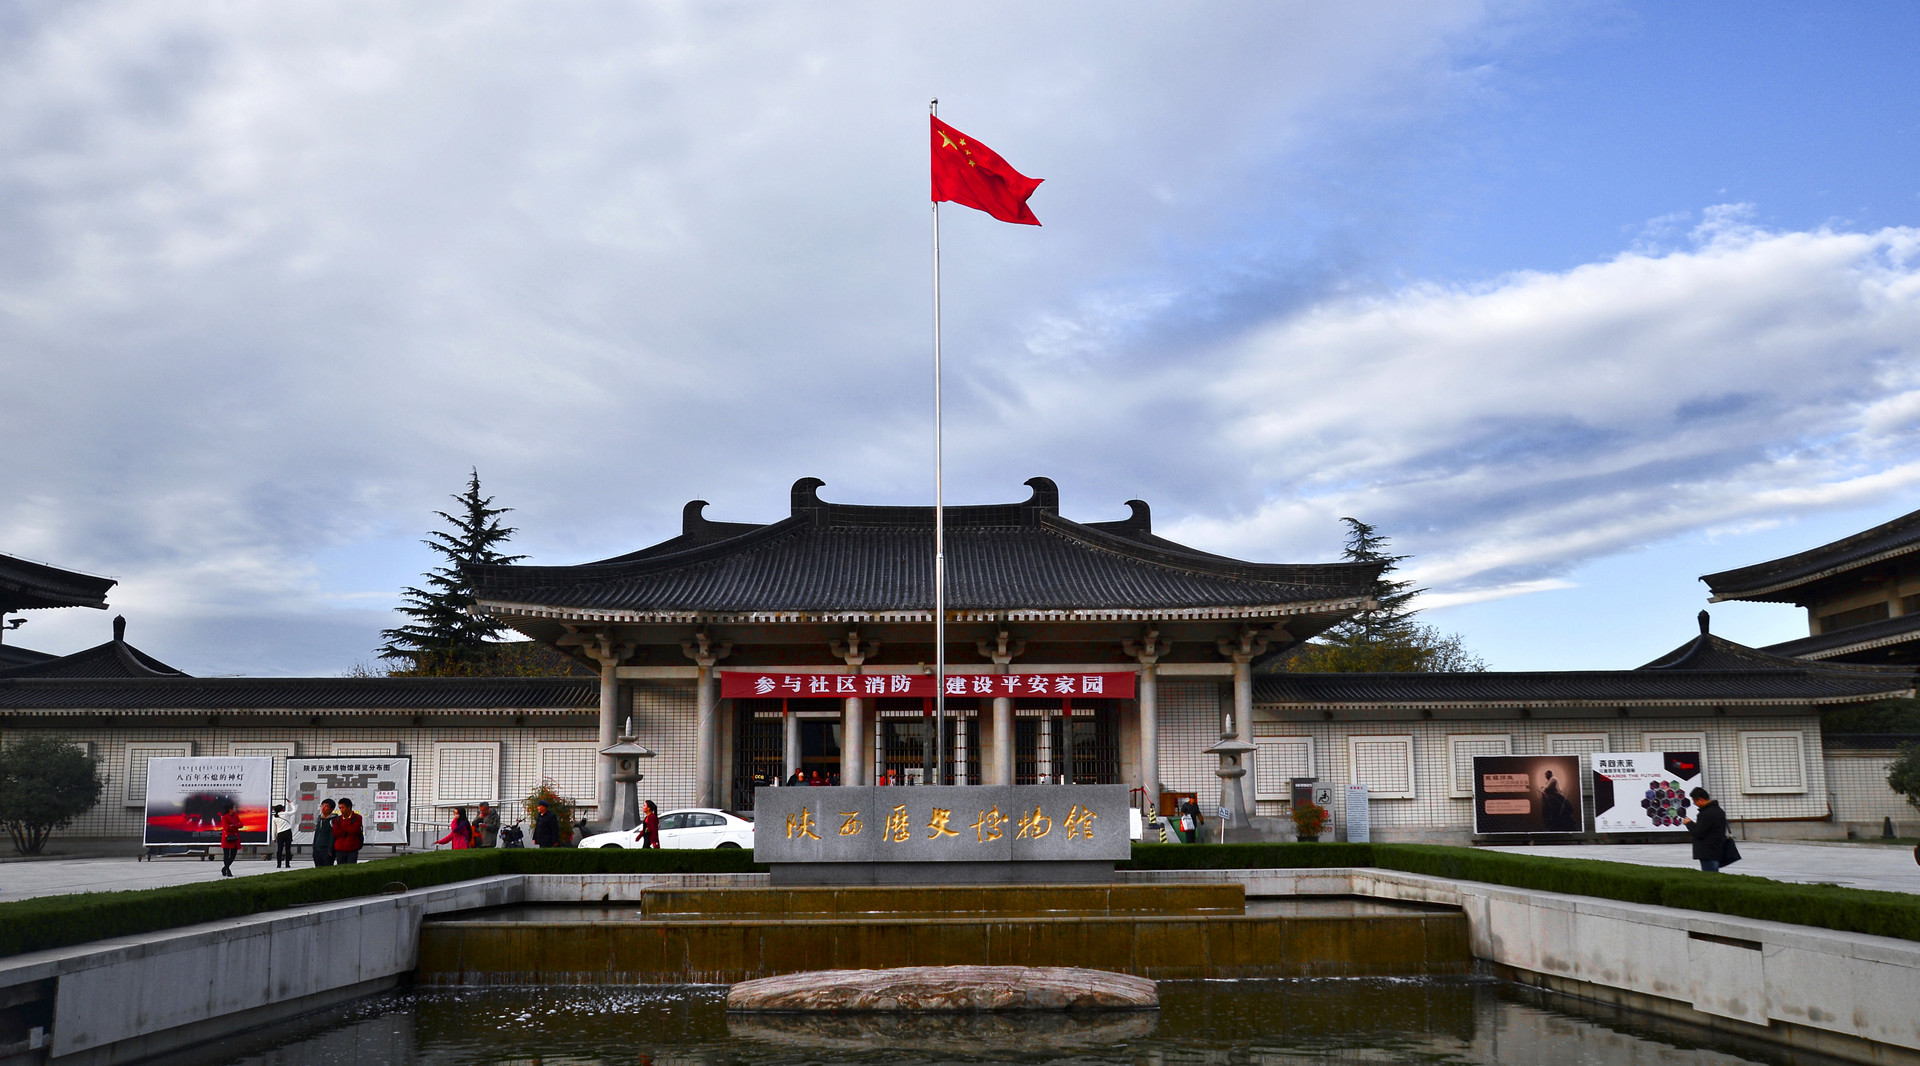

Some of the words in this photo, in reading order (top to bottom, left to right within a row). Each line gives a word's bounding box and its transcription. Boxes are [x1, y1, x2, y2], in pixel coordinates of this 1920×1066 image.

[754, 674, 913, 695] 参与社区消防
[945, 674, 1104, 695] 建设平安家园
[303, 764, 391, 772] 陕西历史博物馆展览分布图
[176, 773, 244, 781] 八百年不熄的神灯
